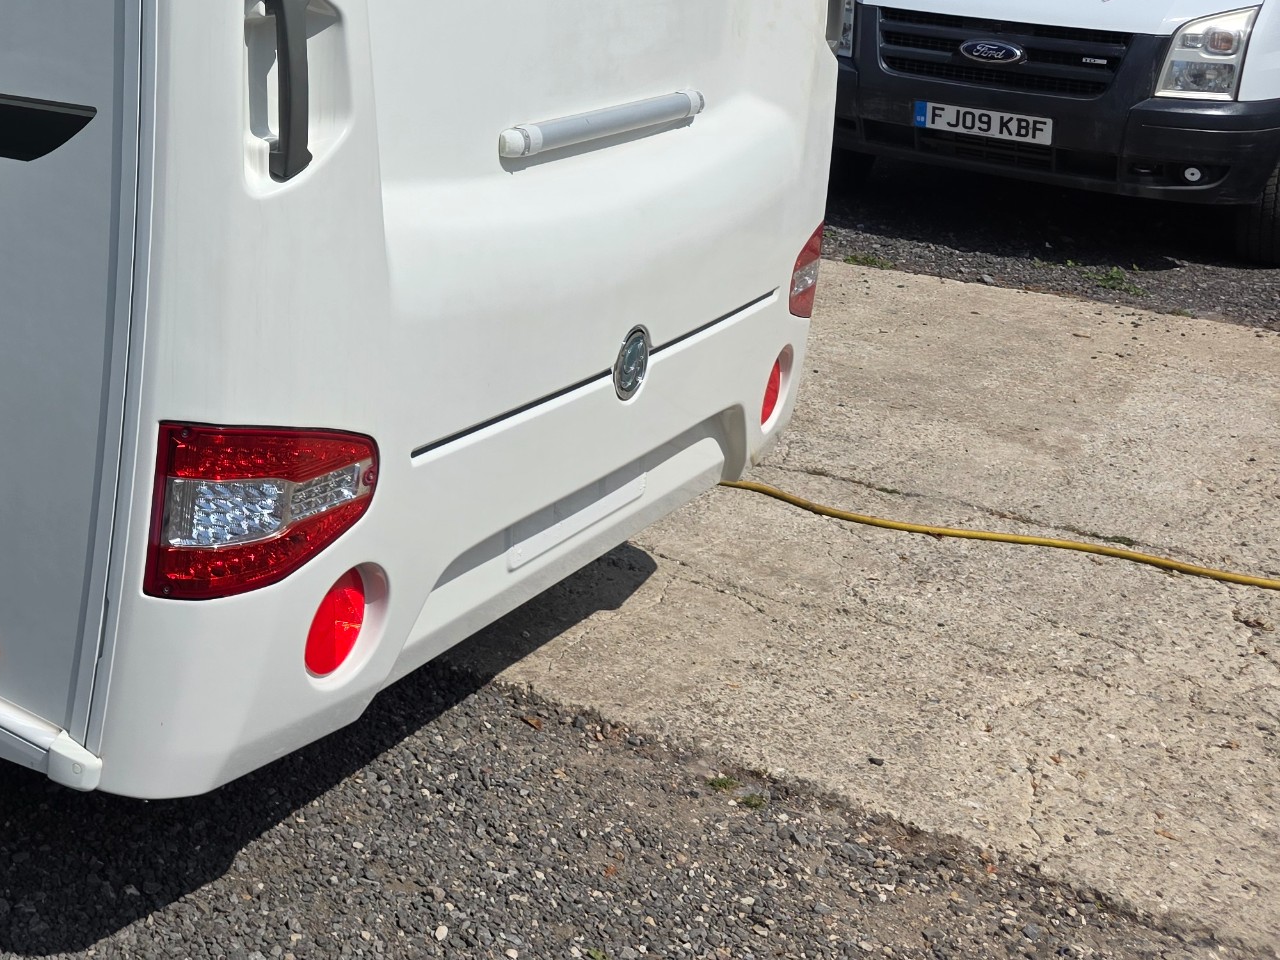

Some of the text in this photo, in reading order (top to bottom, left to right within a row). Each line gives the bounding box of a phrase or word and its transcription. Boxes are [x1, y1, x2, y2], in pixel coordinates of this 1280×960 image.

[972, 43, 1006, 59] Ford
[930, 105, 1048, 140] FJ09 KBF
